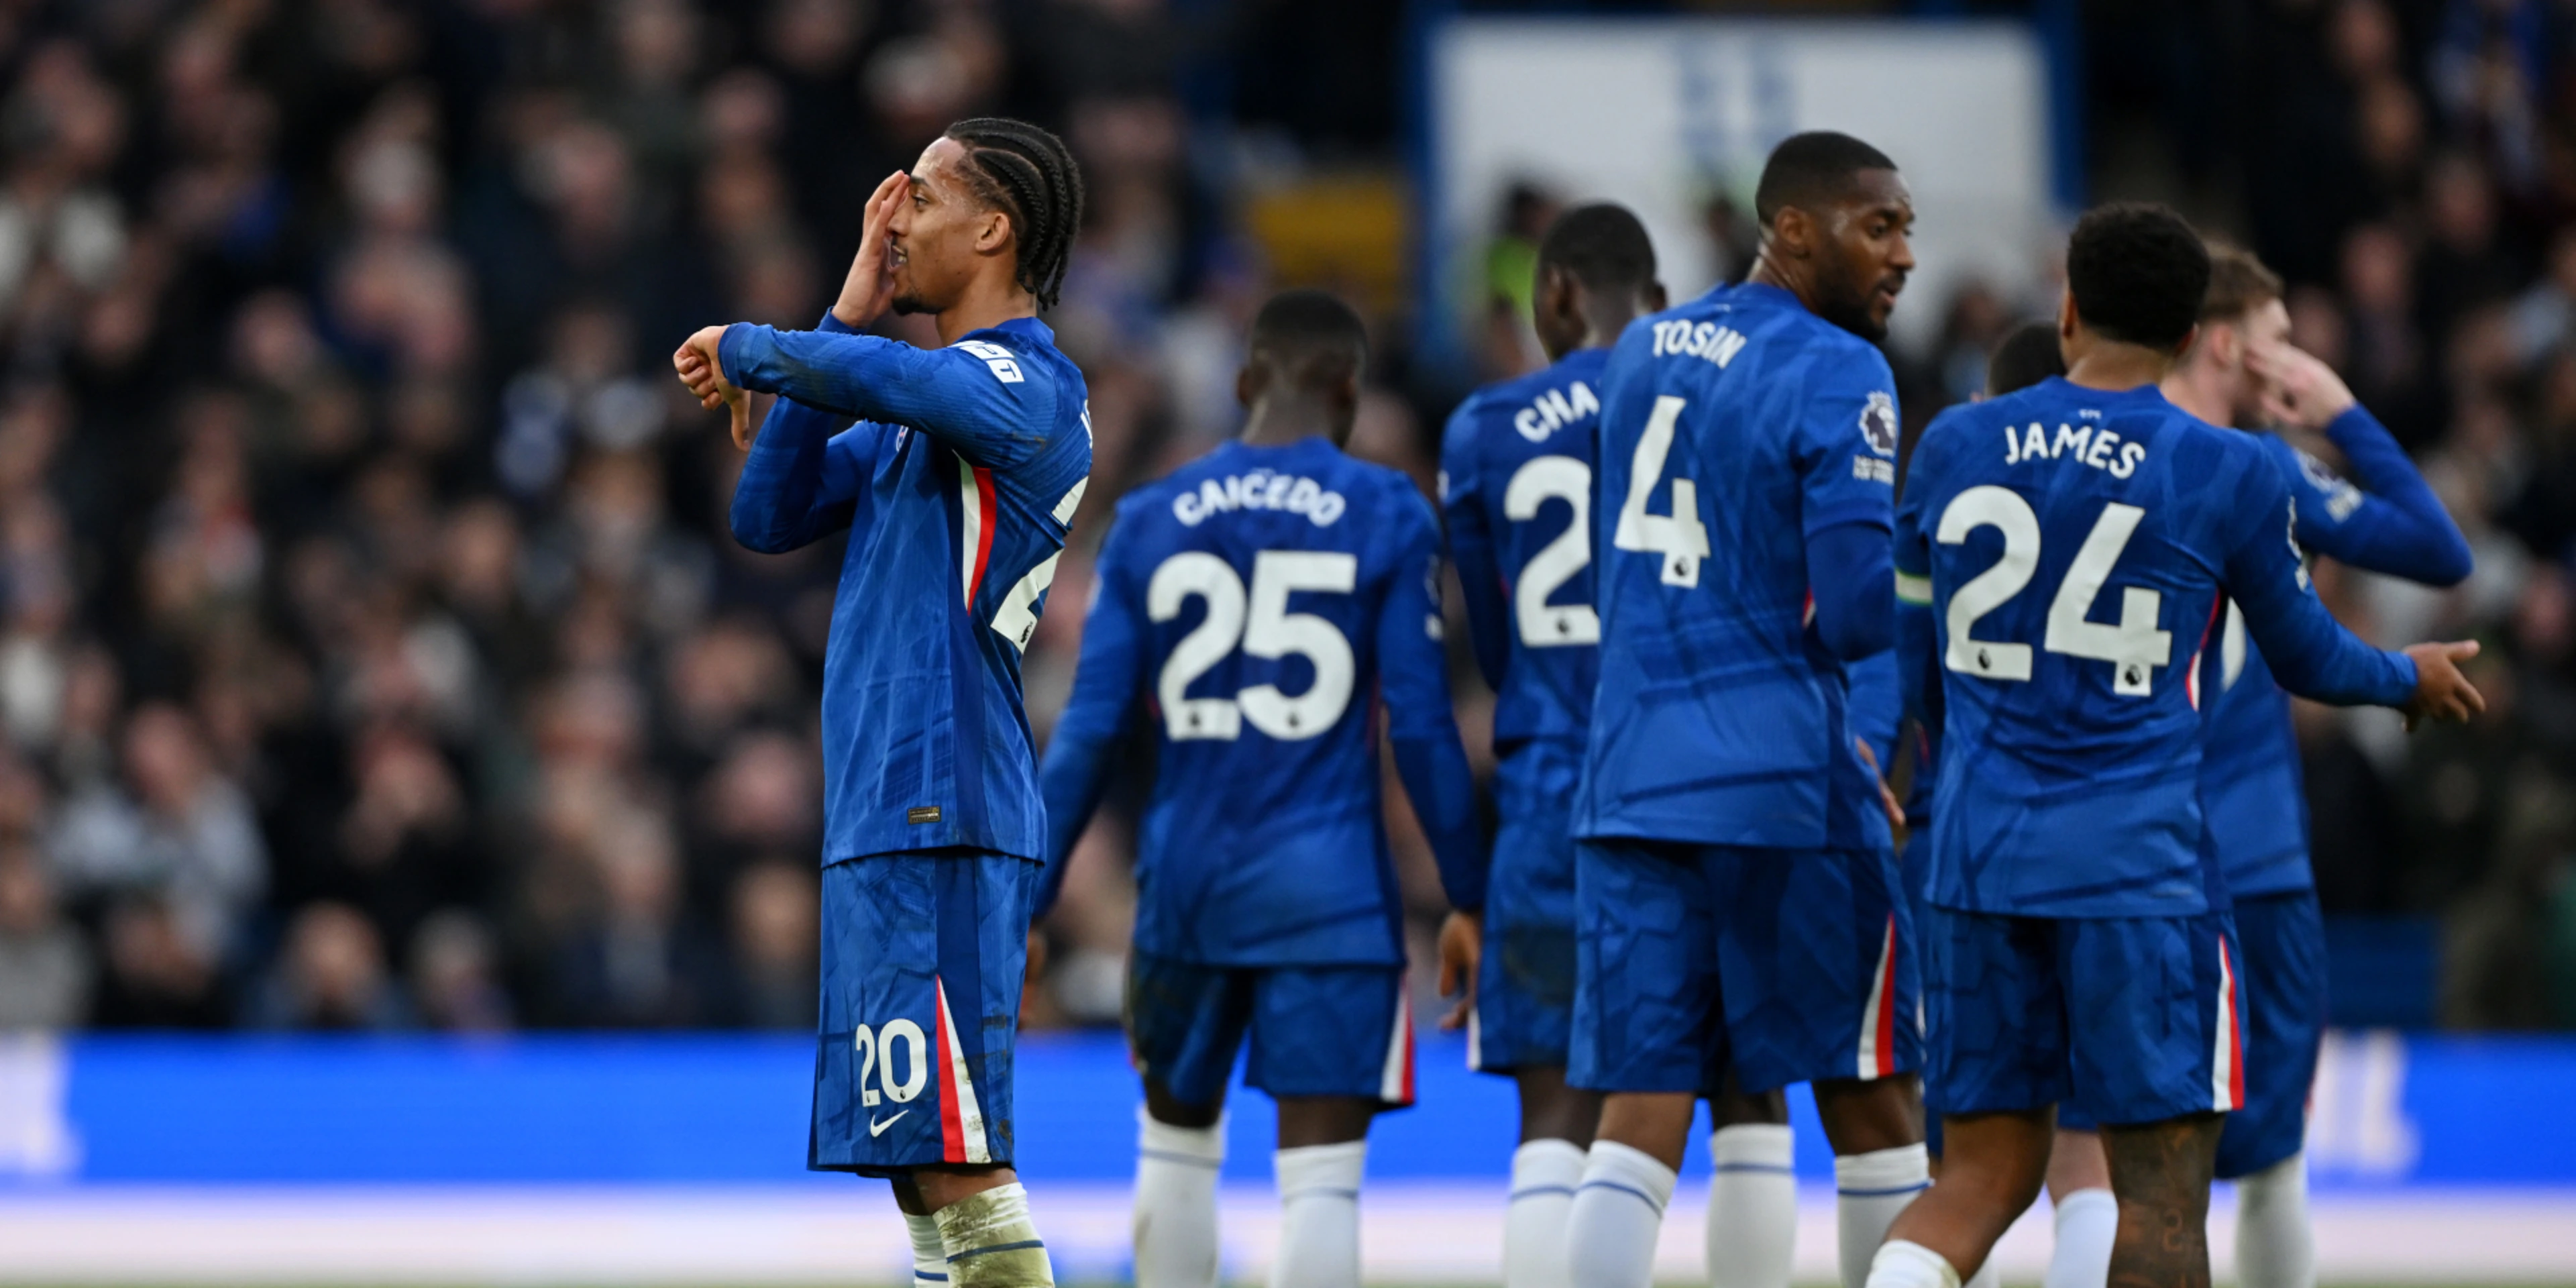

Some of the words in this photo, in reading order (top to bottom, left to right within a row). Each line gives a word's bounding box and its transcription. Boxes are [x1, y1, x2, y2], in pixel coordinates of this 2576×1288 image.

[1652, 319, 1747, 368] TOSIN
[1614, 395, 1710, 588] 4
[2006, 423, 2145, 478] JAMES
[1173, 472, 1345, 527] CAICEDO
[1936, 485, 2171, 696] 24
[1148, 549, 1356, 740] 25
[855, 1018, 927, 1107] 20
